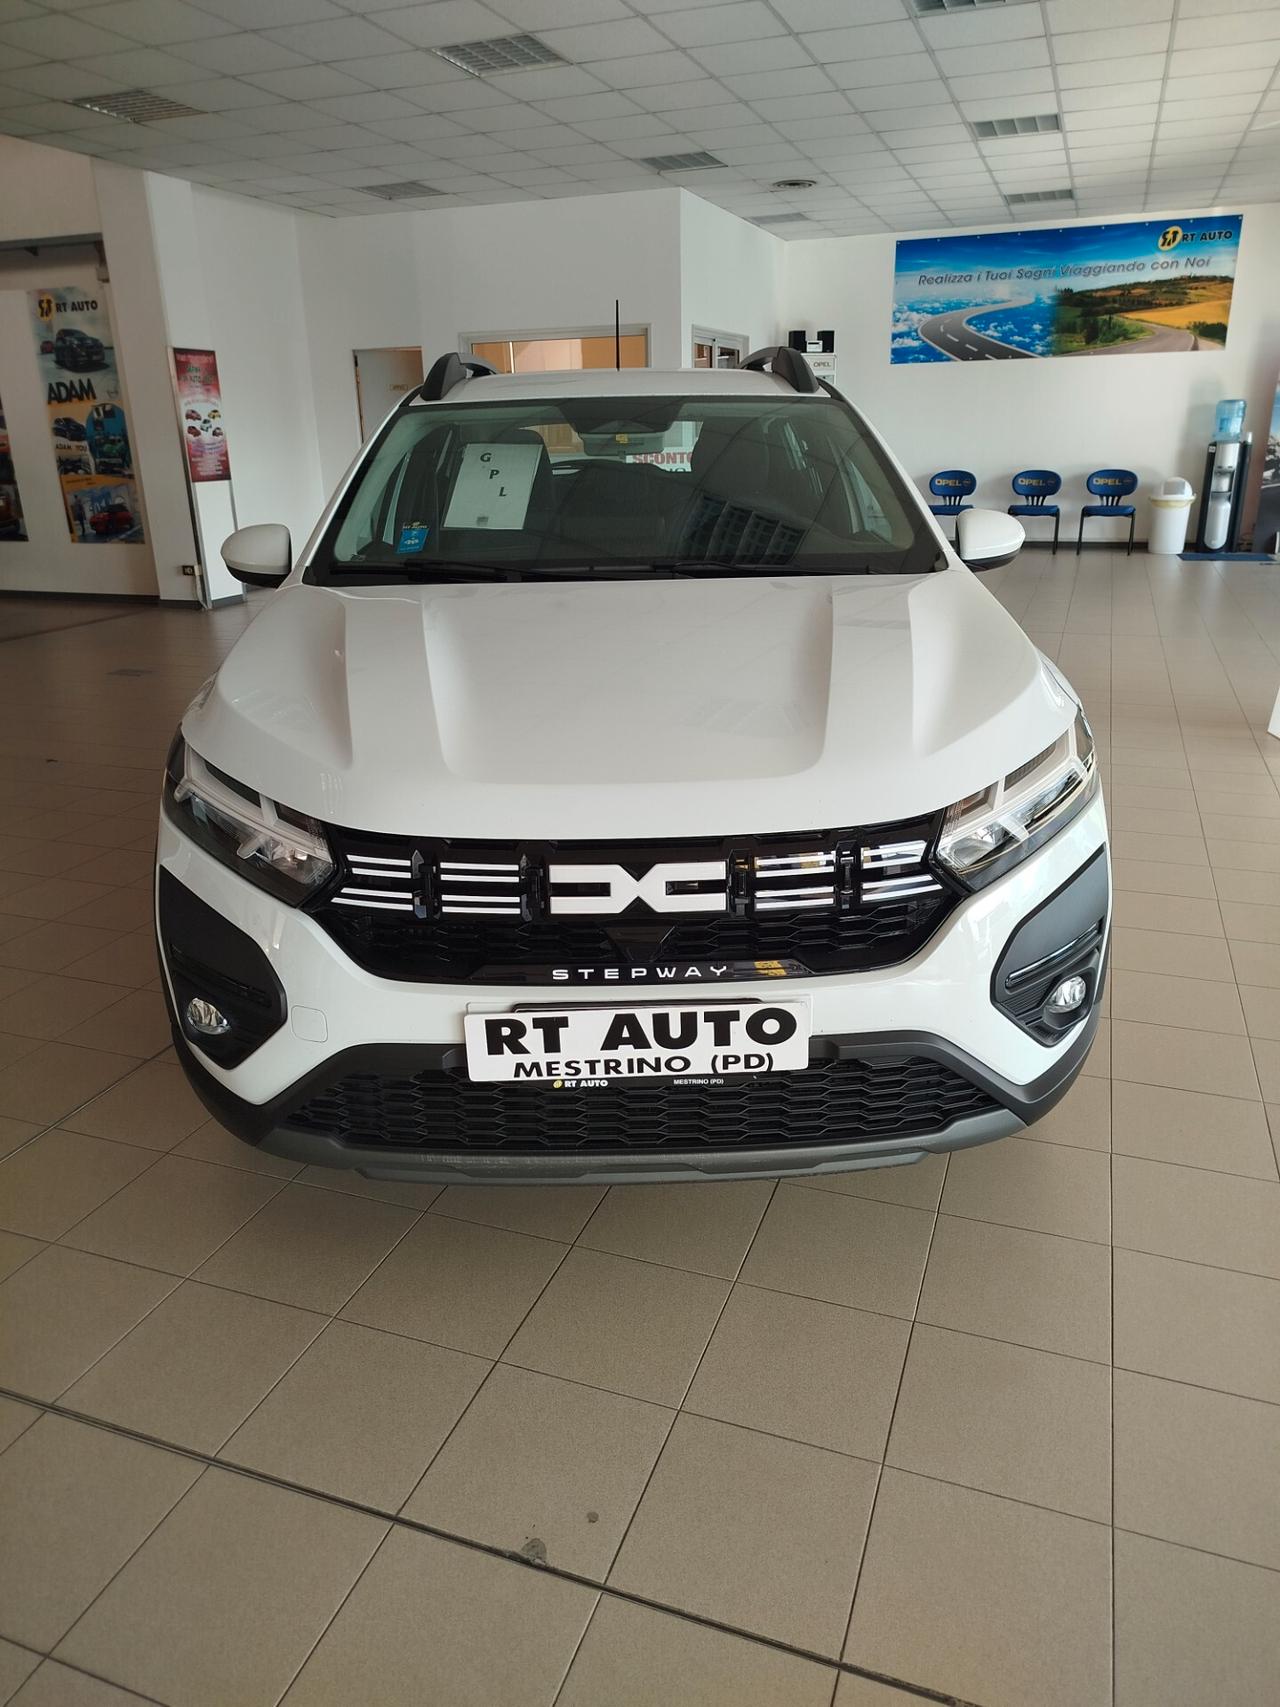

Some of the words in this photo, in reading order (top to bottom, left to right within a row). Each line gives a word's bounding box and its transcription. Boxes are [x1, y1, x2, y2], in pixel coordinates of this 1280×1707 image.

[1181, 233, 1196, 242] RT
[1200, 231, 1233, 241] AUTO
[918, 272, 973, 286] Realizza
[1059, 261, 1146, 278] Viaggiando
[1151, 258, 1179, 271] con
[1184, 256, 1212, 268] Noi
[55, 302, 68, 312] RT
[71, 300, 98, 311] AUTO
[47, 378, 97, 405] ADAM
[934, 478, 962, 487] OPEL
[1018, 478, 1046, 487] OPEL
[1092, 477, 1122, 486] OPEL
[552, 965, 727, 980] STEPWAY
[484, 1016, 569, 1056] RT
[600, 1007, 797, 1051] AUTO
[513, 1055, 691, 1078] MESTRINO
[710, 1052, 774, 1074] (PD)
[564, 1079, 577, 1088] RT
[580, 1079, 609, 1088] AUTO
